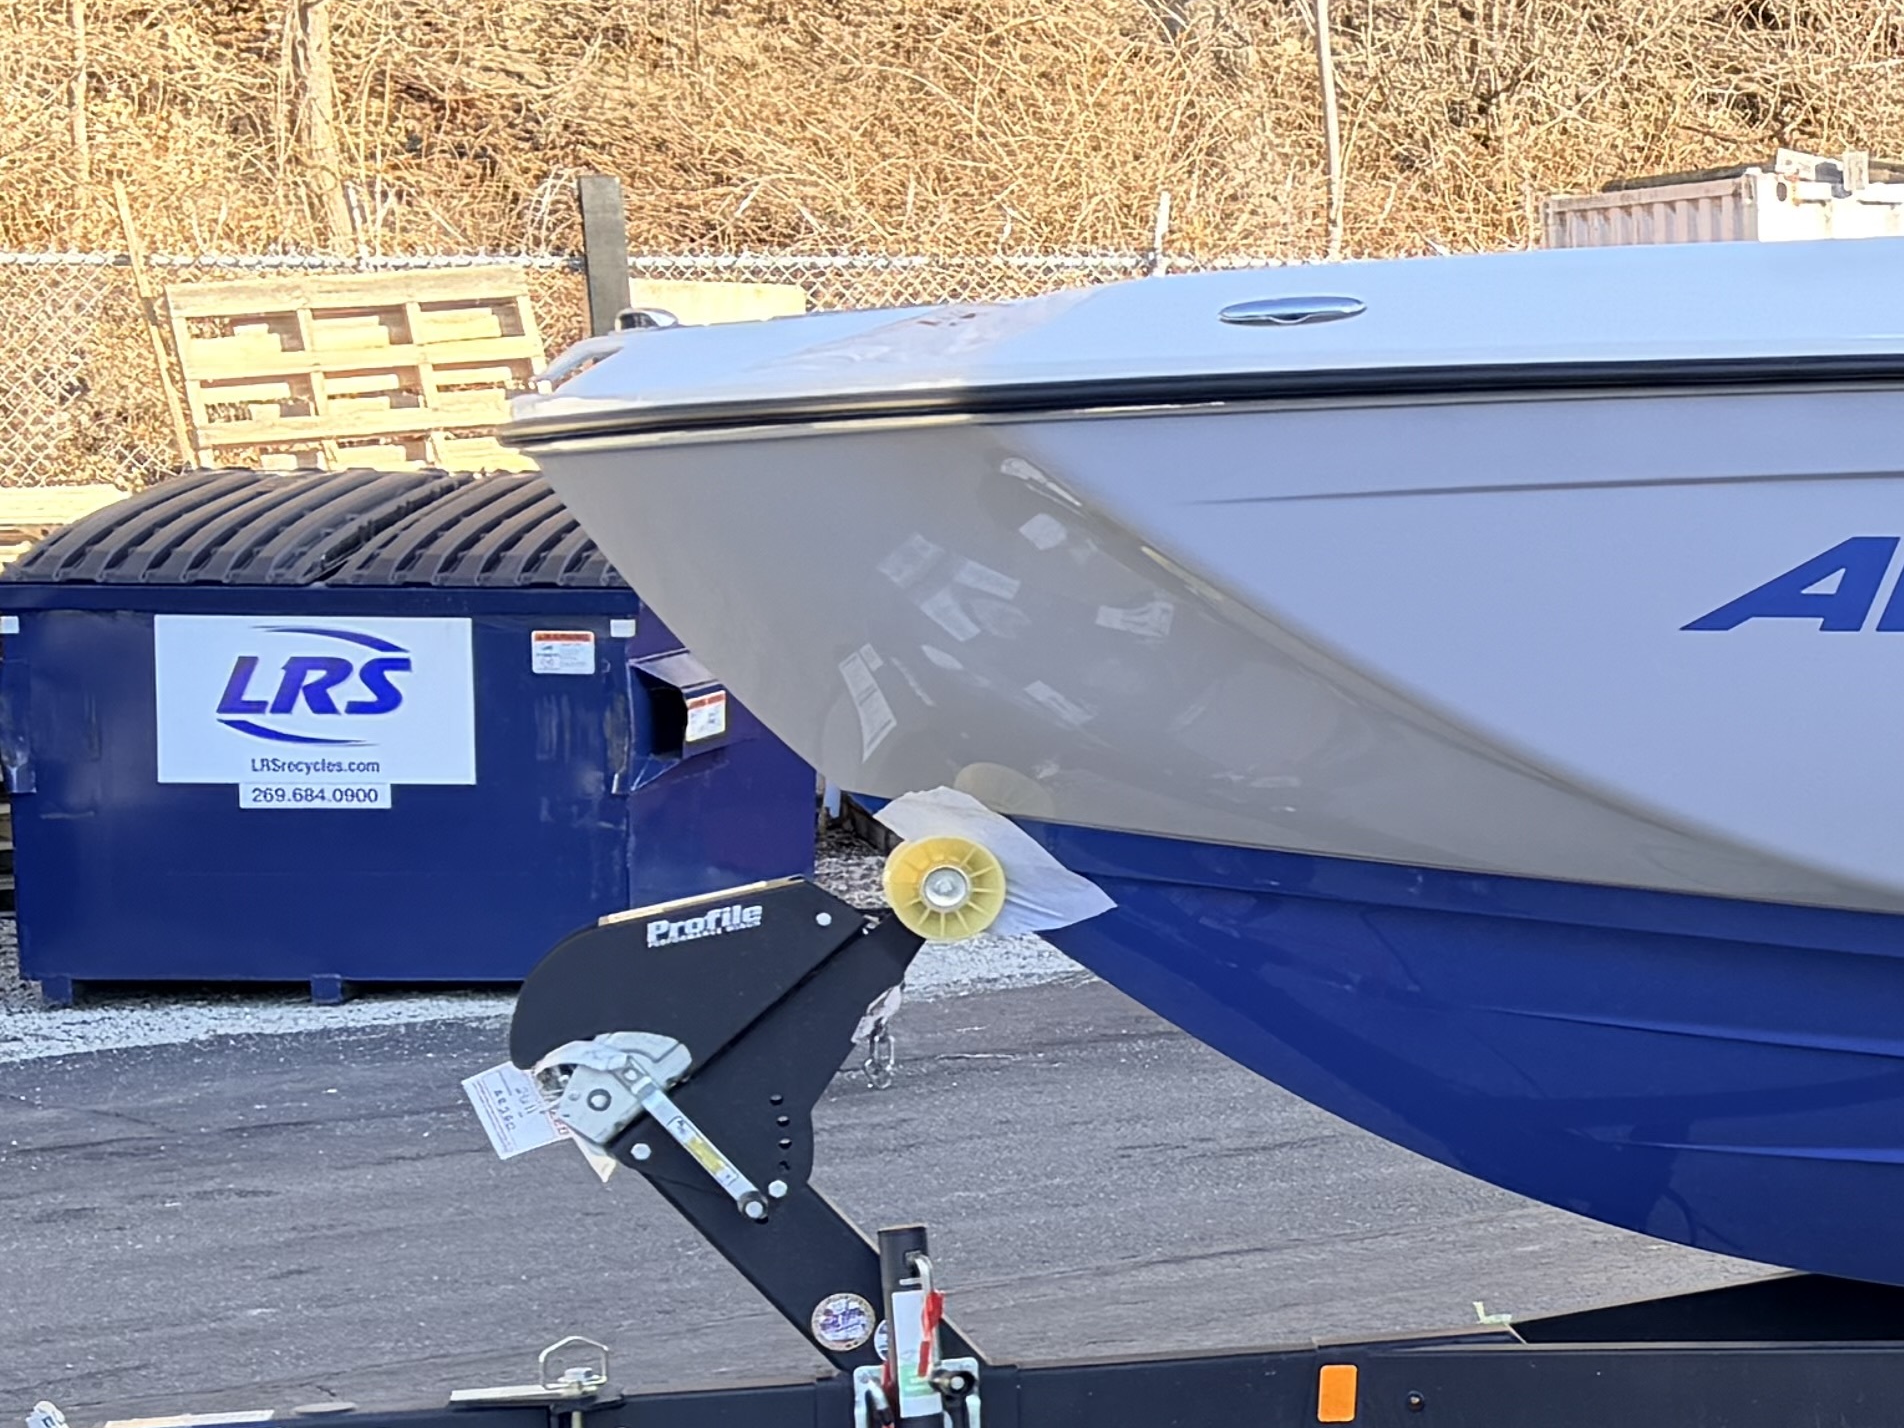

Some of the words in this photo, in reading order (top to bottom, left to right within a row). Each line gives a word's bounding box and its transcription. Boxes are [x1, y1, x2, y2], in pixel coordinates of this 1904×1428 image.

[216, 656, 412, 715] LRS
[251, 758, 380, 775] LRSrecycles.com
[252, 787, 379, 803] 269.684.0900
[647, 905, 763, 943] Profile
